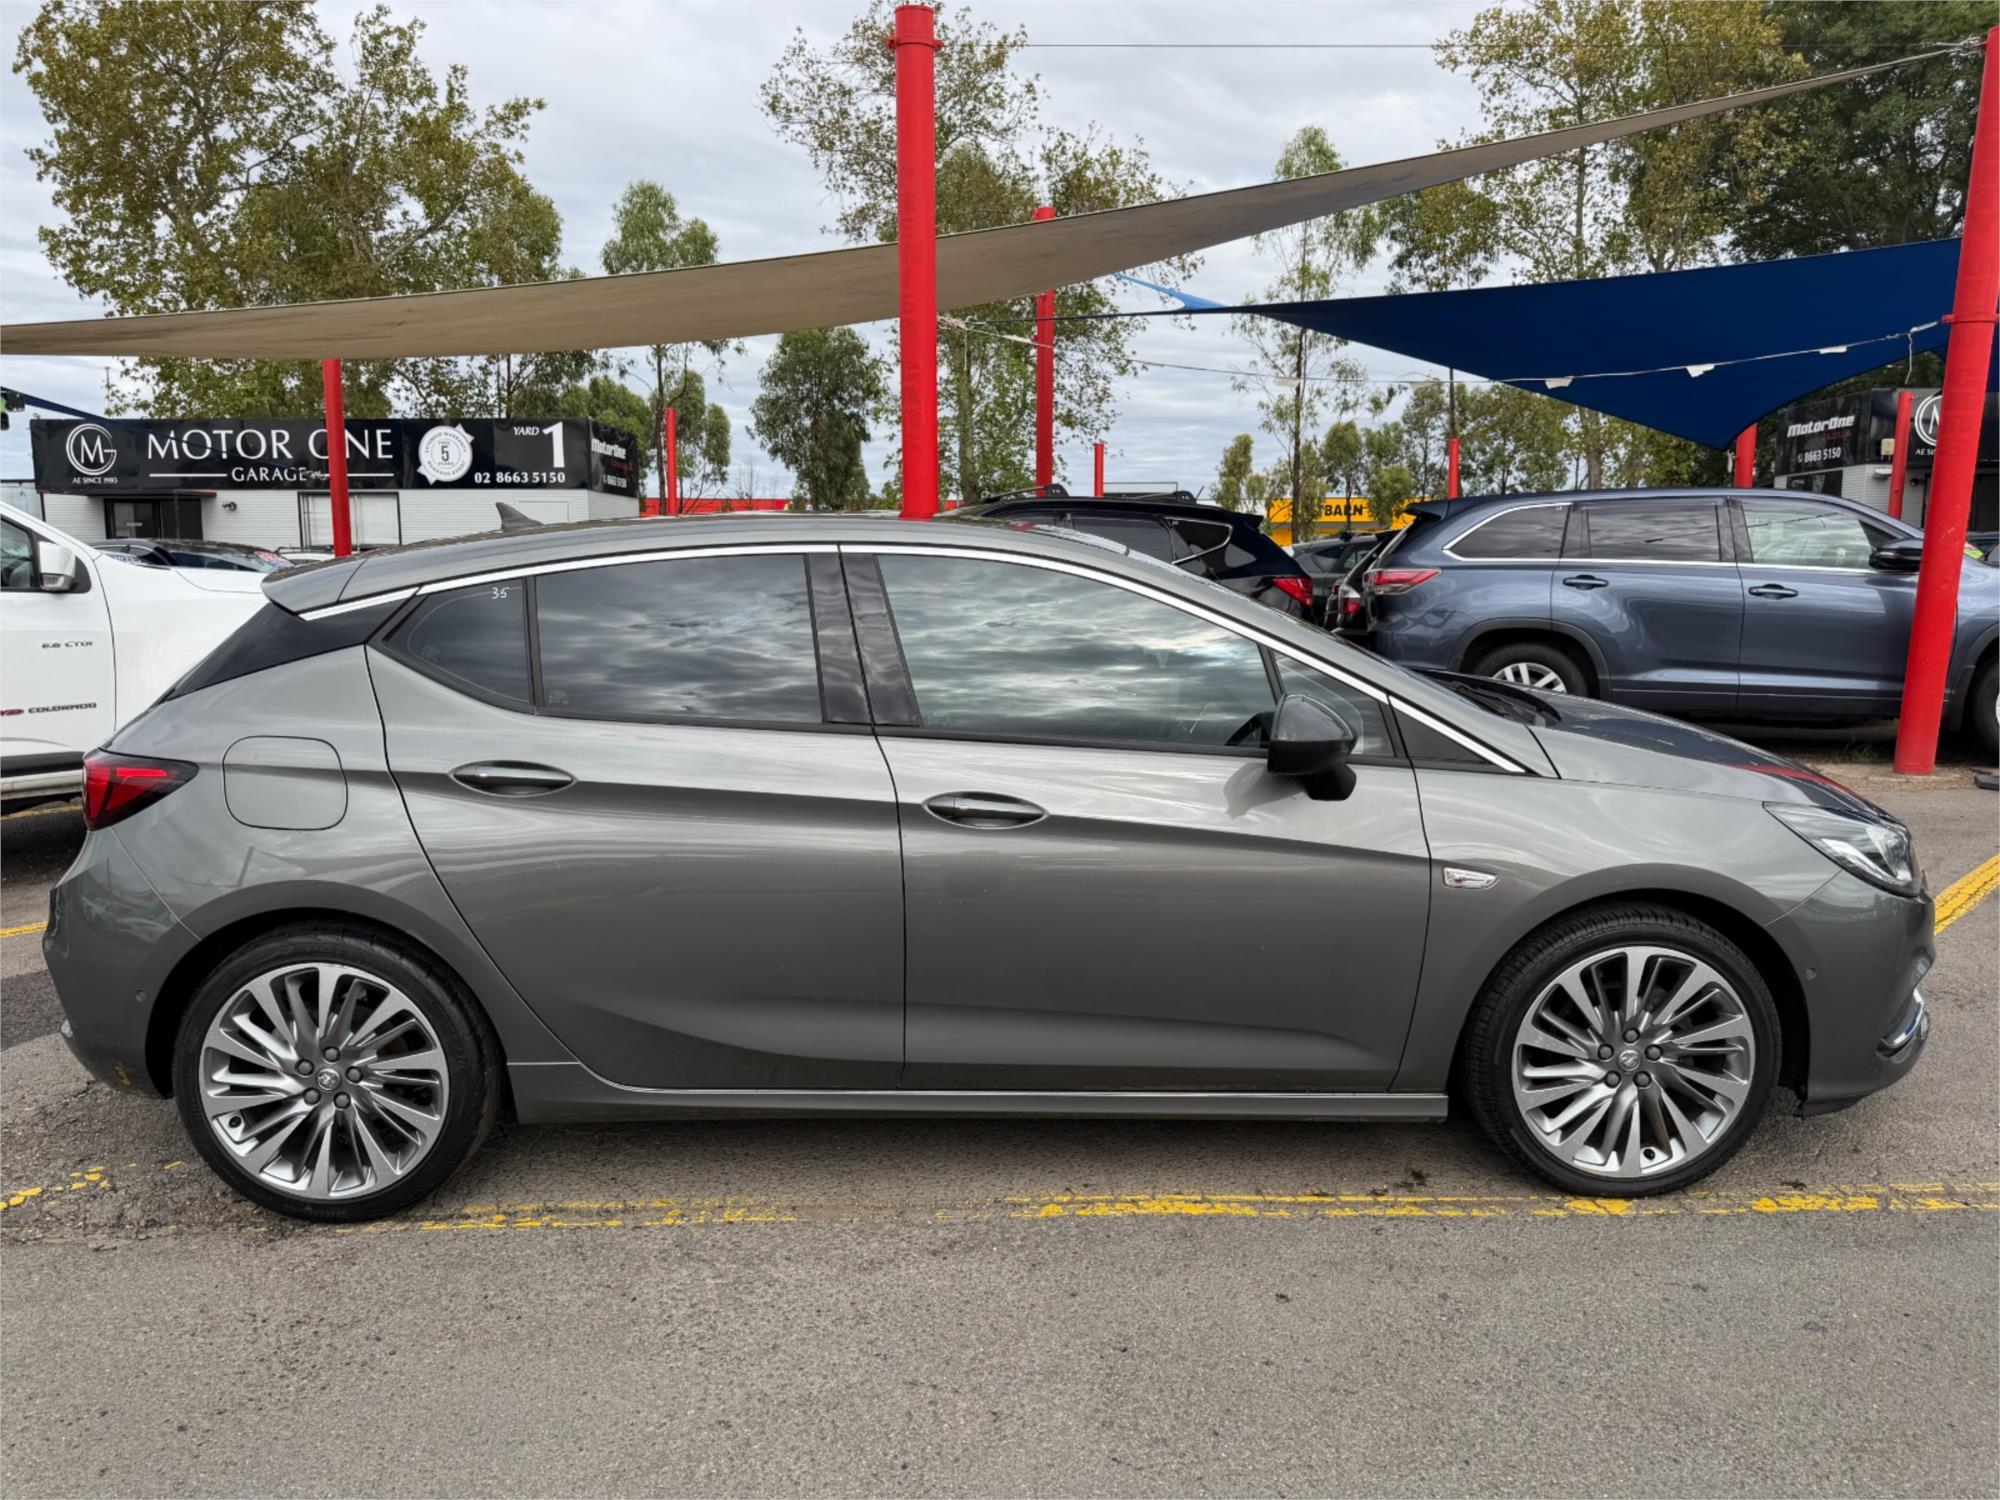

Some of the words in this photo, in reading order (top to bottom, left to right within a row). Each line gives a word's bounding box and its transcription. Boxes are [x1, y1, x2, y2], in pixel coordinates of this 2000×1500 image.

[148, 428, 293, 460] MOTOR
[308, 428, 393, 460] ONE
[513, 426, 540, 436] YARD
[542, 421, 565, 468] 1
[441, 445, 449, 462] 5
[1823, 447, 1841, 460] 5150
[231, 466, 307, 482] GARAGE
[474, 471, 491, 484] 02
[495, 471, 529, 484] 8663
[532, 471, 566, 484] 5150
[491, 586, 510, 600] 35
[28, 702, 97, 714] COLORADO
